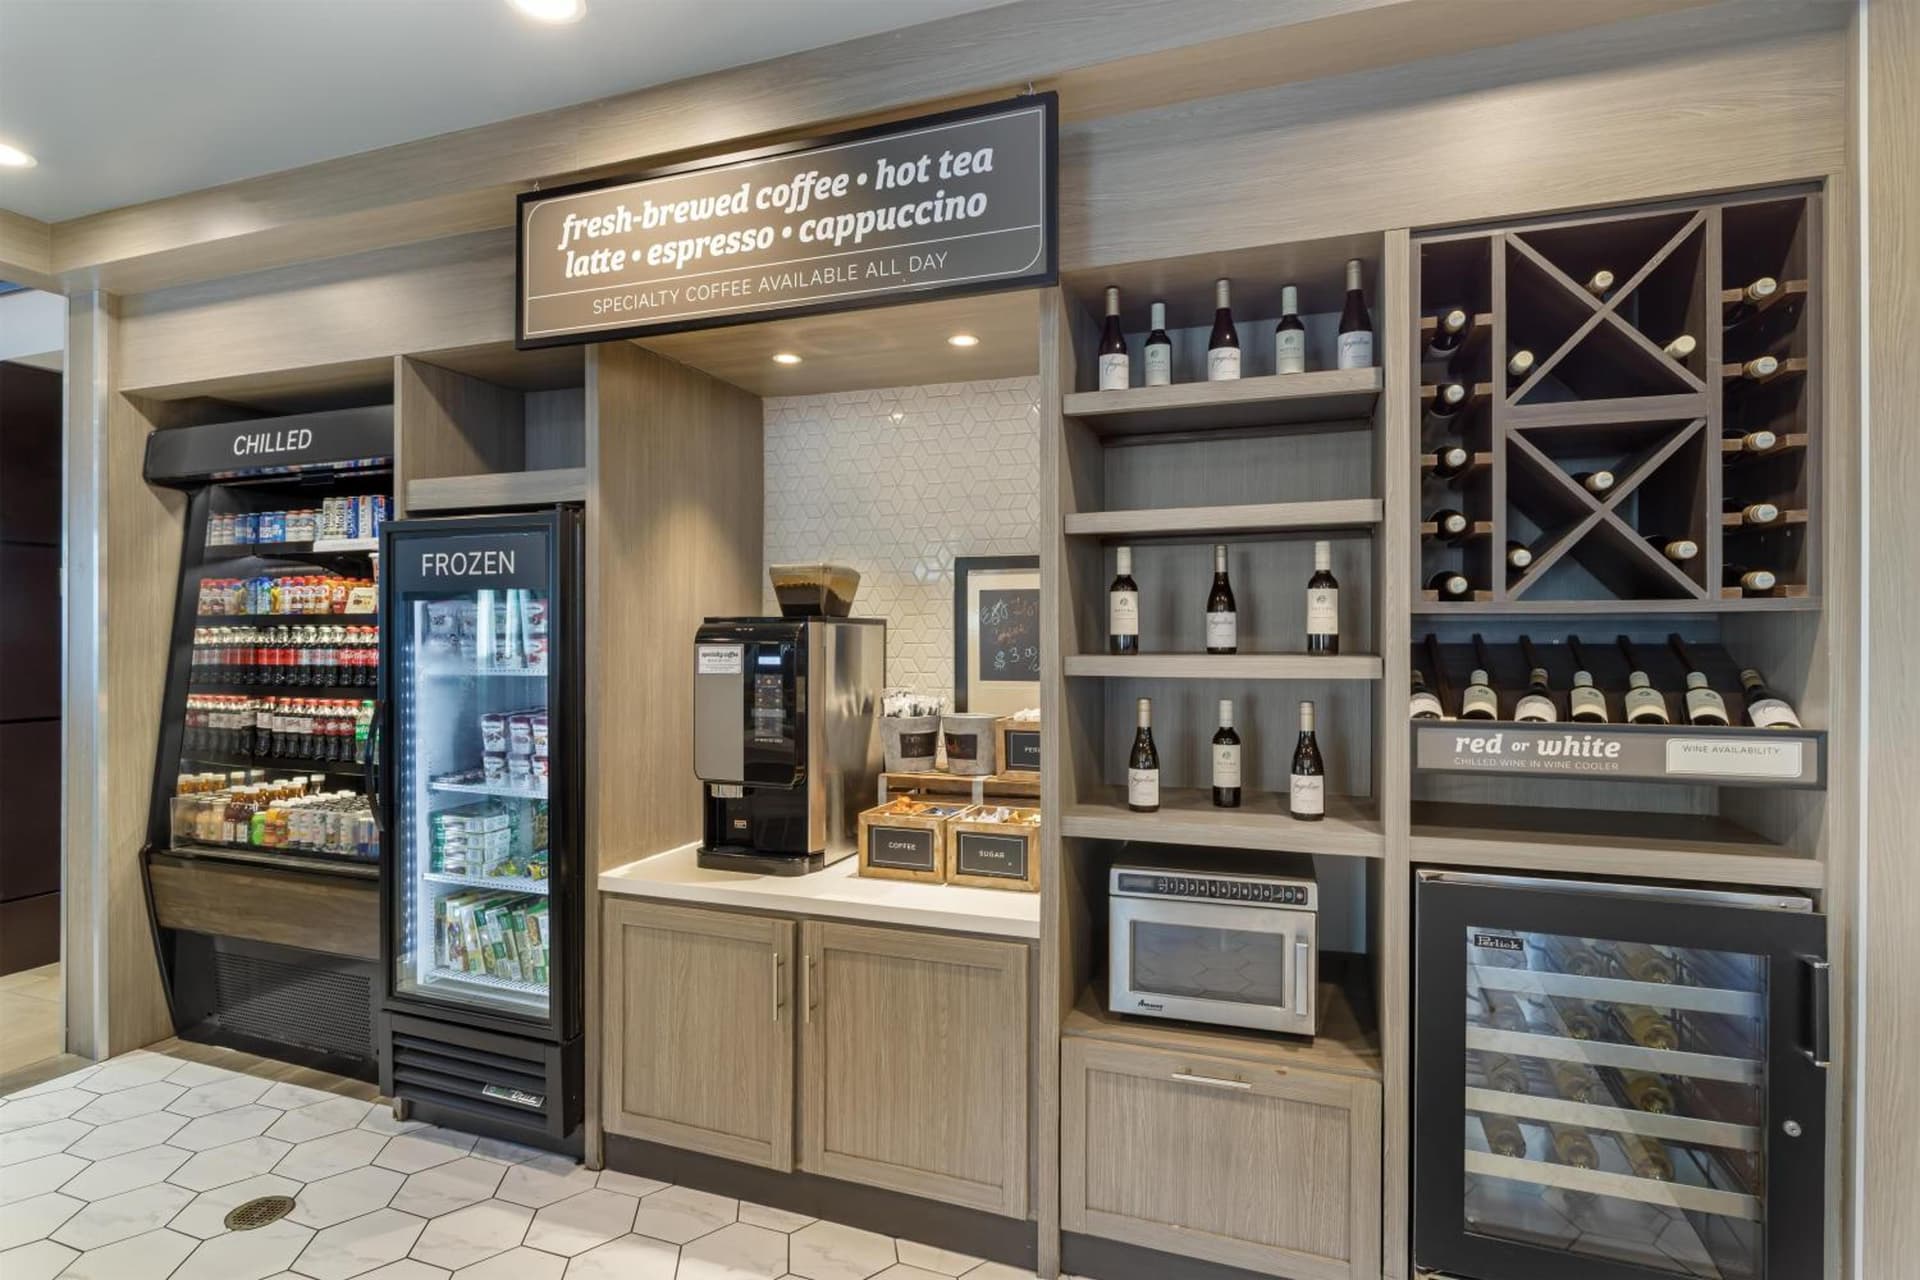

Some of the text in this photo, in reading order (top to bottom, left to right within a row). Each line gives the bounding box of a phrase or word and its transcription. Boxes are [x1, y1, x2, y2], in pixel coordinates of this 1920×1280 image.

[558, 147, 993, 251] fresh-brewed coffee hot tea
[565, 189, 988, 278] latte espresso cappuccino
[592, 251, 949, 315] SPECIALTY COFFEE AVAILABLE ALL DAY
[233, 428, 313, 456] CHILLED
[421, 550, 515, 576] FROZEN
[1456, 733, 1622, 758] red or white
[1682, 745, 1781, 755] WINE AVAILABILITY
[1453, 757, 1619, 771] CHILLED WINE IN WINE COOLER
[889, 841, 916, 851] COFFEE
[978, 850, 1005, 858] SUGAR
